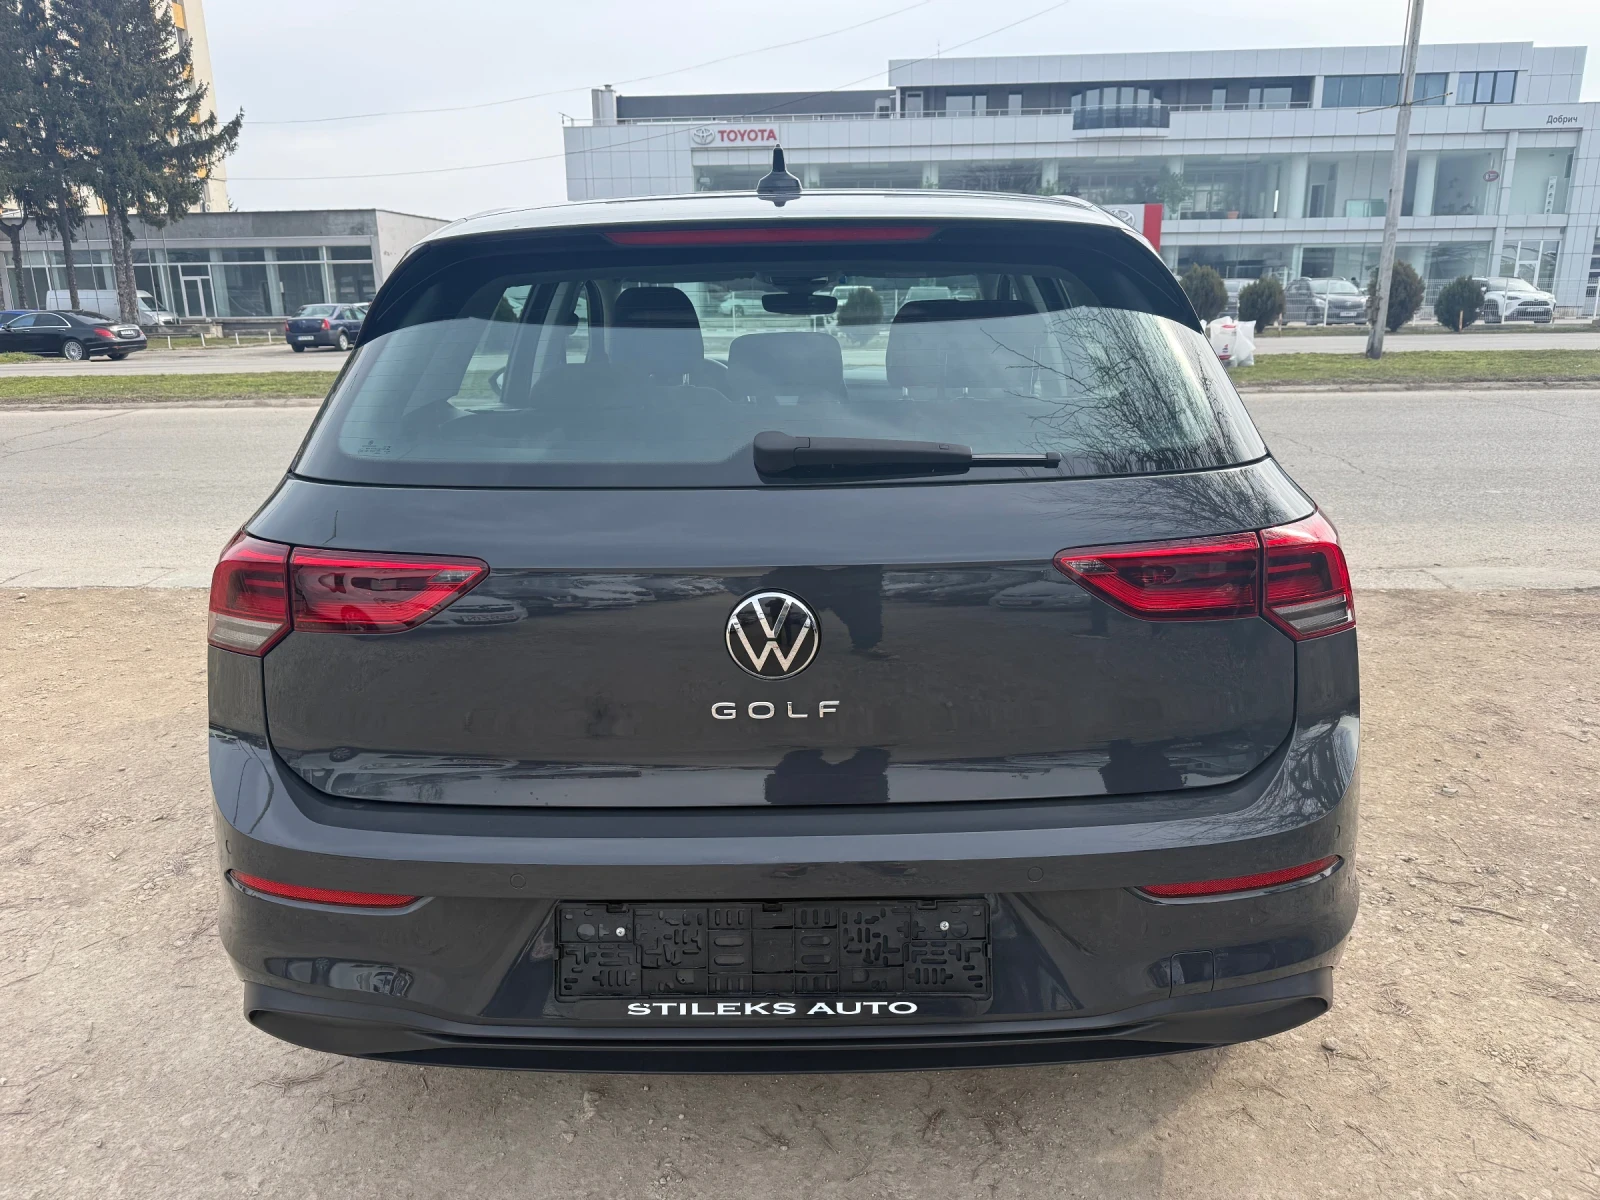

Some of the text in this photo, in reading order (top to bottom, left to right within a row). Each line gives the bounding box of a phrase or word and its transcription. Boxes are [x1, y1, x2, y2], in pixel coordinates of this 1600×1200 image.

[1546, 115, 1578, 125] Добрич
[718, 128, 777, 142] TOYOTA
[726, 592, 819, 679] VW
[711, 700, 840, 720] GOLF
[627, 1001, 918, 1017] STILEKS AUTO
